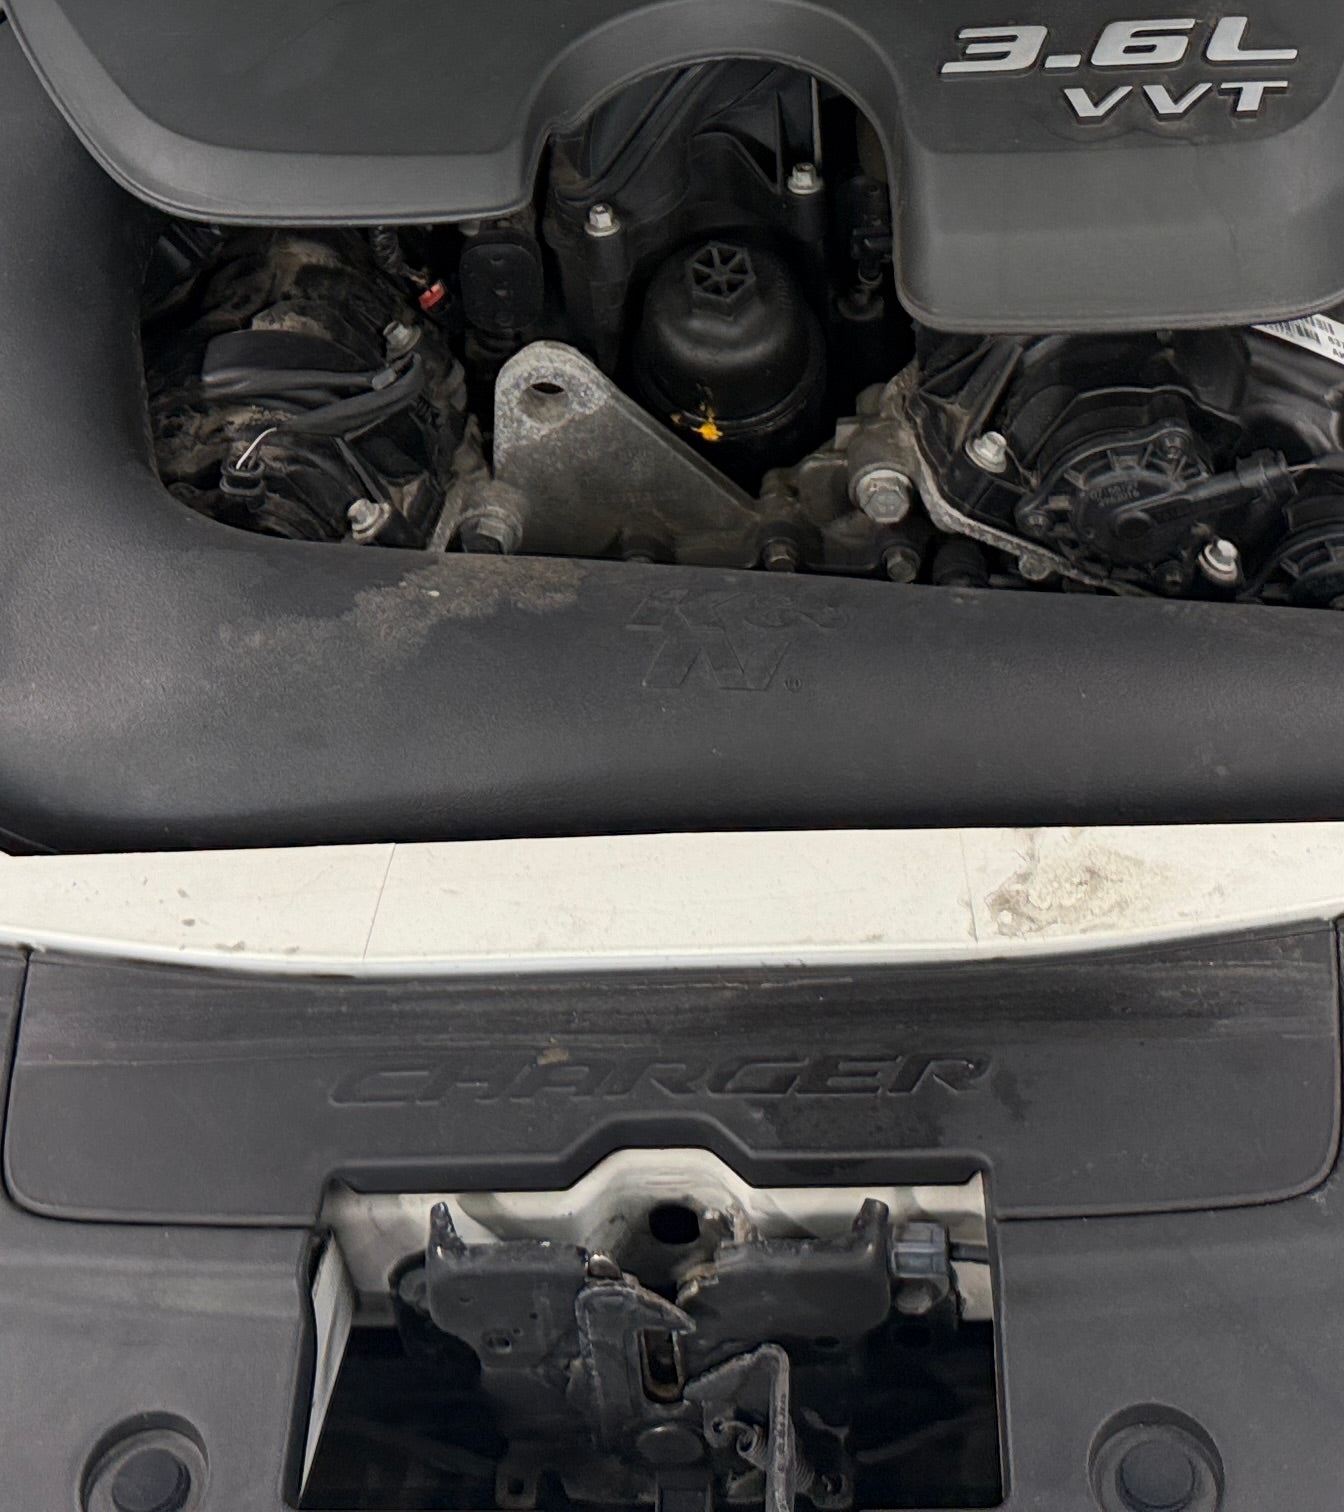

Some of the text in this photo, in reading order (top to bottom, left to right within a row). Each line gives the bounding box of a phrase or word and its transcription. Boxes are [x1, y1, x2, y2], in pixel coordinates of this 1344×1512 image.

[939, 16, 1299, 74] 3.6L
[1062, 80, 1289, 119] VVT
[329, 1052, 994, 1107] CHARGER
